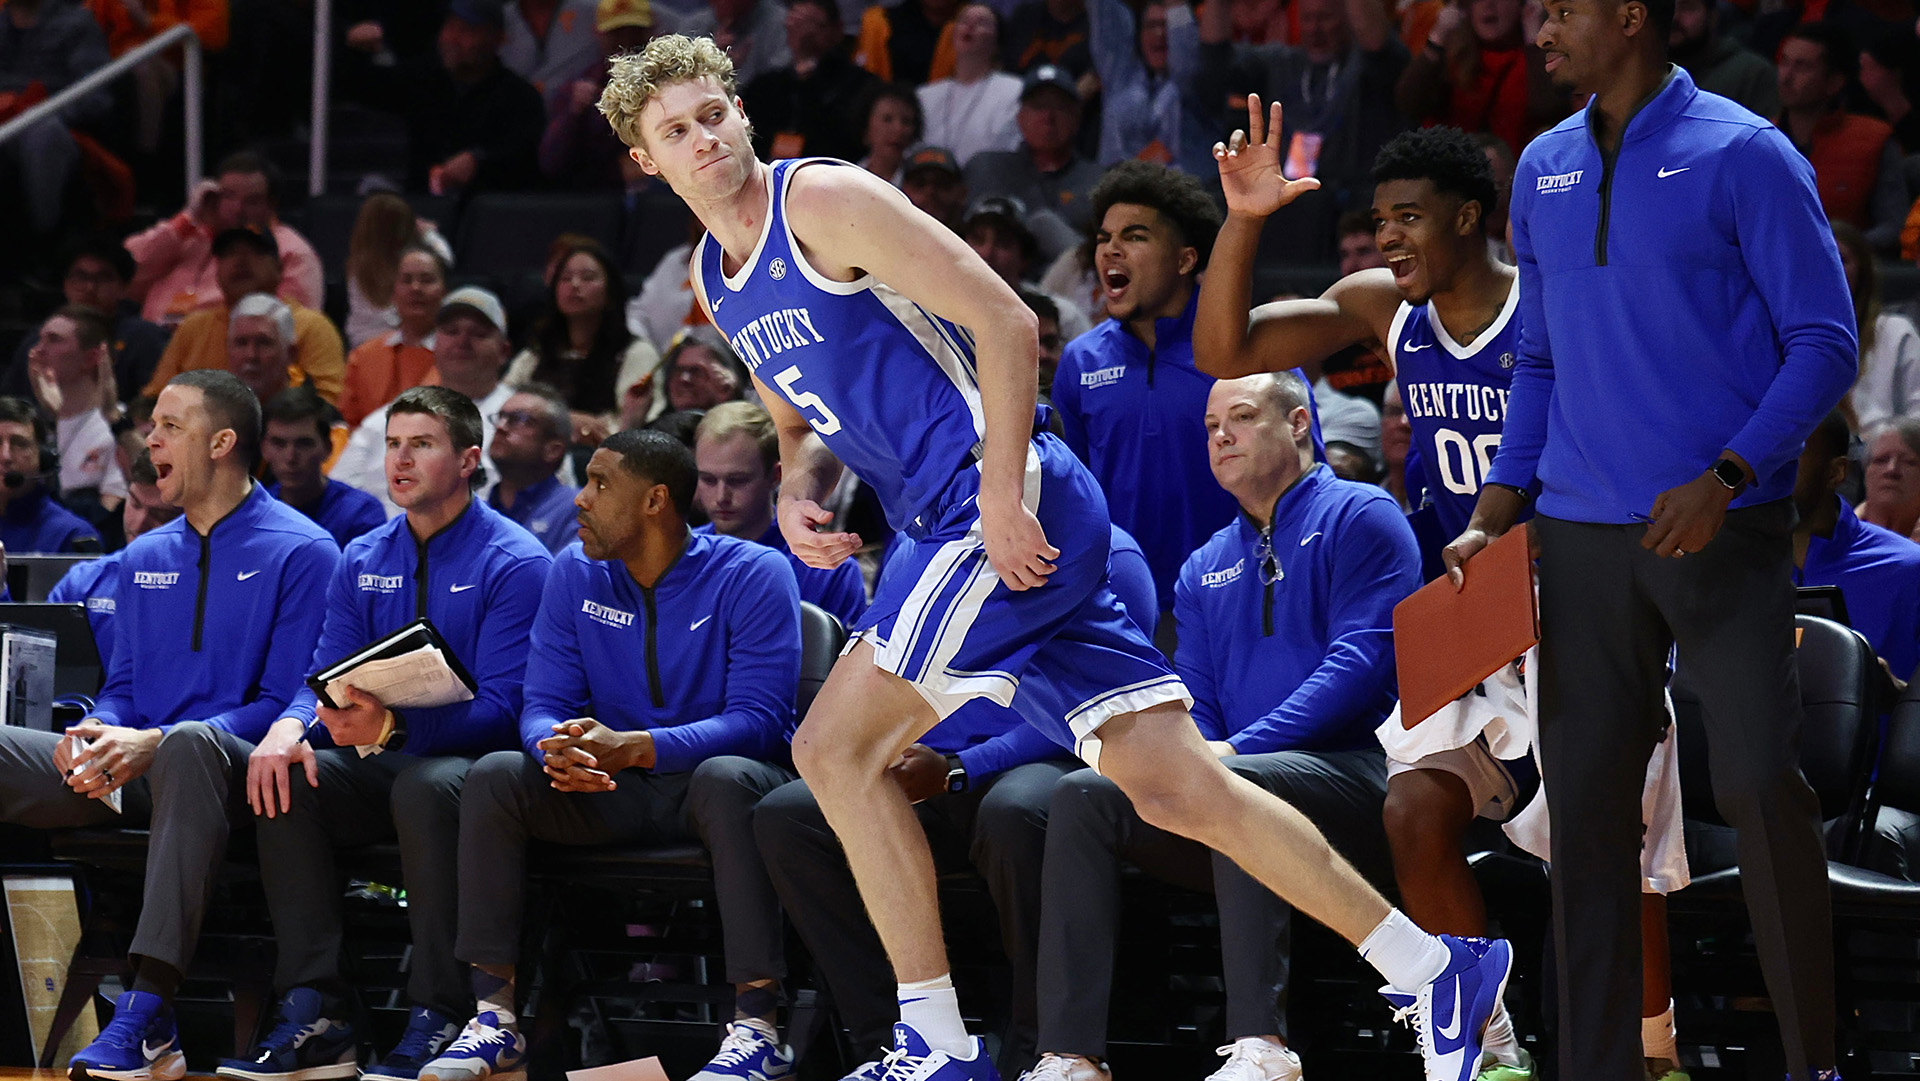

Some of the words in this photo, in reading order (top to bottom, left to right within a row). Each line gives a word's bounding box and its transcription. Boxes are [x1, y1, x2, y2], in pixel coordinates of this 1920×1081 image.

[1536, 170, 1584, 191] KENTUCKY
[731, 308, 825, 374] ENTUCKY
[1080, 366, 1126, 385] KENTUCKY
[772, 364, 842, 436] 5
[133, 571, 180, 584] KENTUCKY
[1201, 558, 1245, 586] KENTUCKY
[581, 599, 635, 626] KENTUCKY
